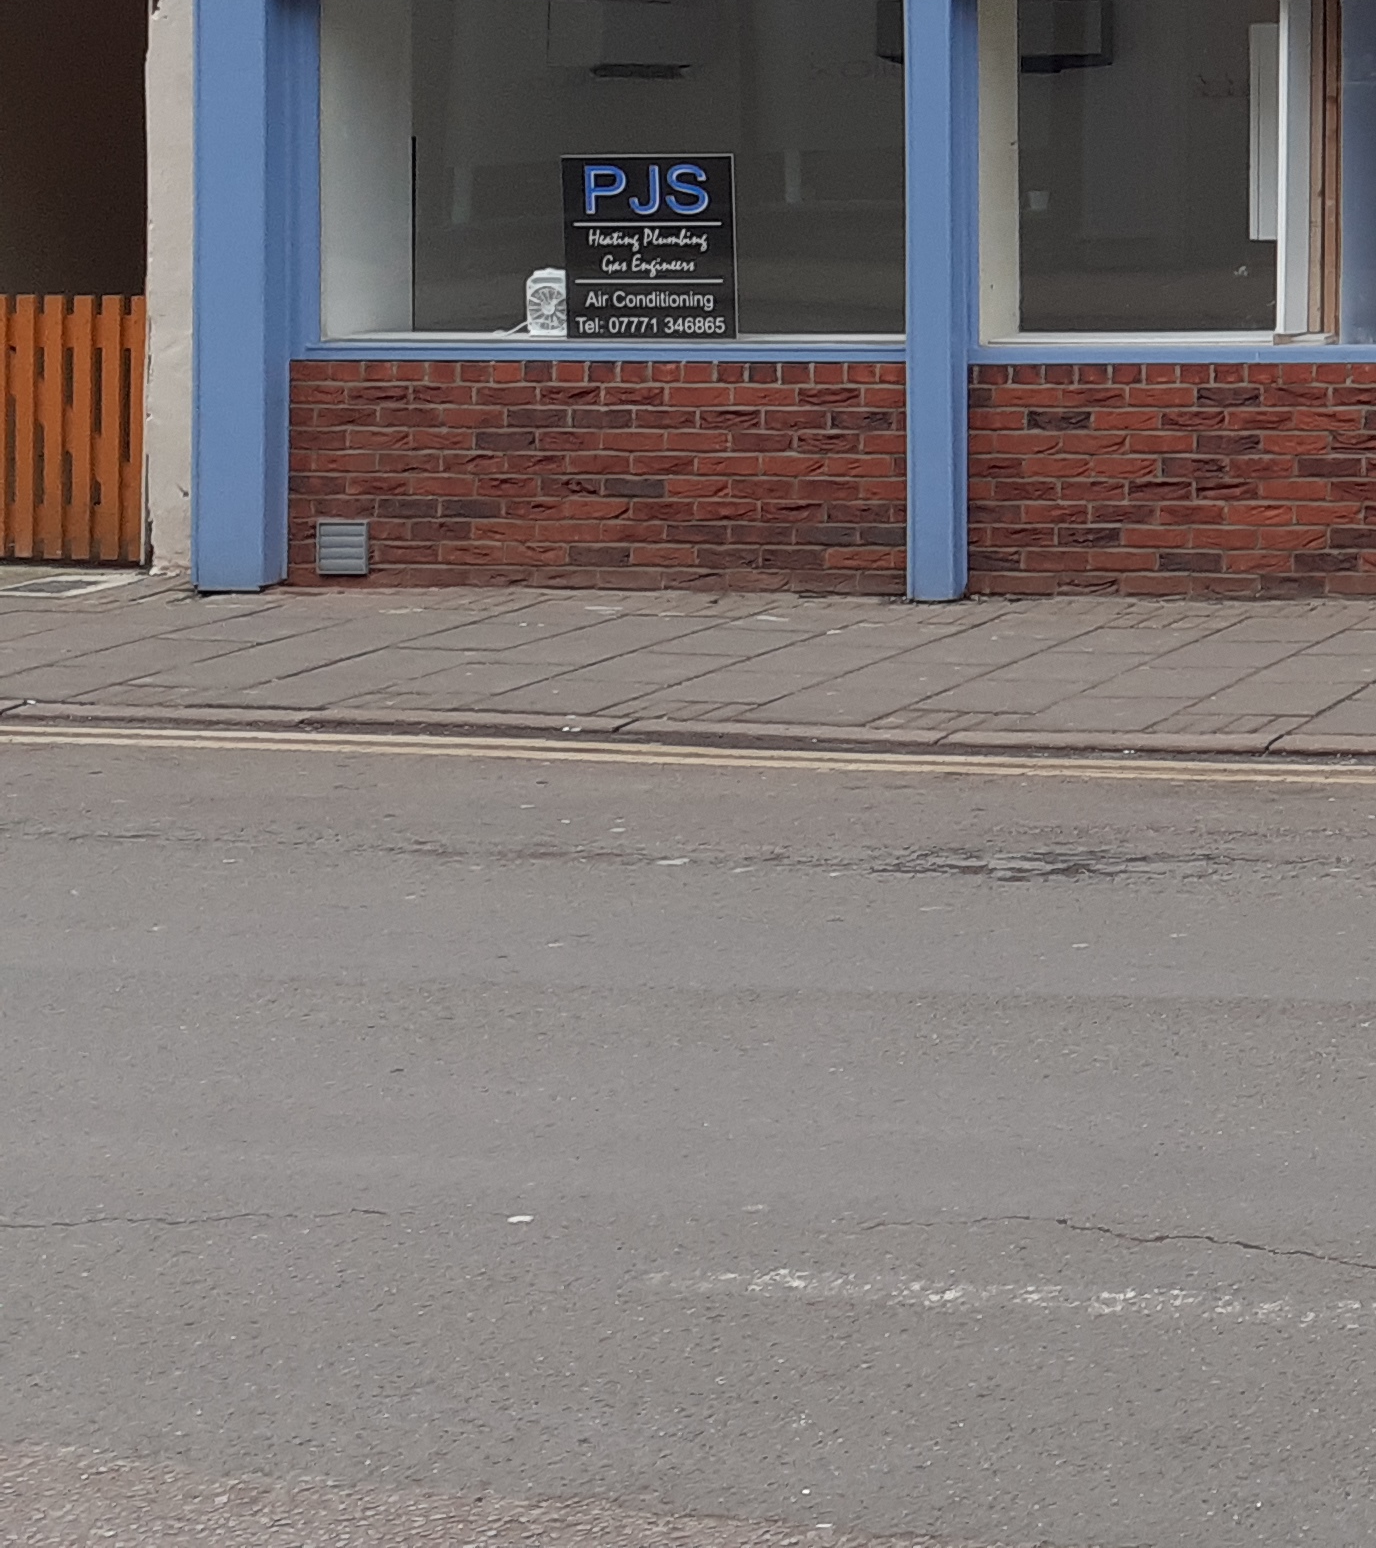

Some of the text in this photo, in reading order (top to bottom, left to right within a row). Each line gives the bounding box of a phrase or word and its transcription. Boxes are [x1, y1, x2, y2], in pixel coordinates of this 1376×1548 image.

[584, 164, 709, 215] PJS
[588, 228, 708, 252] Heating Plumbing
[601, 254, 695, 277] Gas Engineers
[584, 291, 714, 311] Air Conditioning
[575, 316, 726, 333] Tel: 07771 346865
